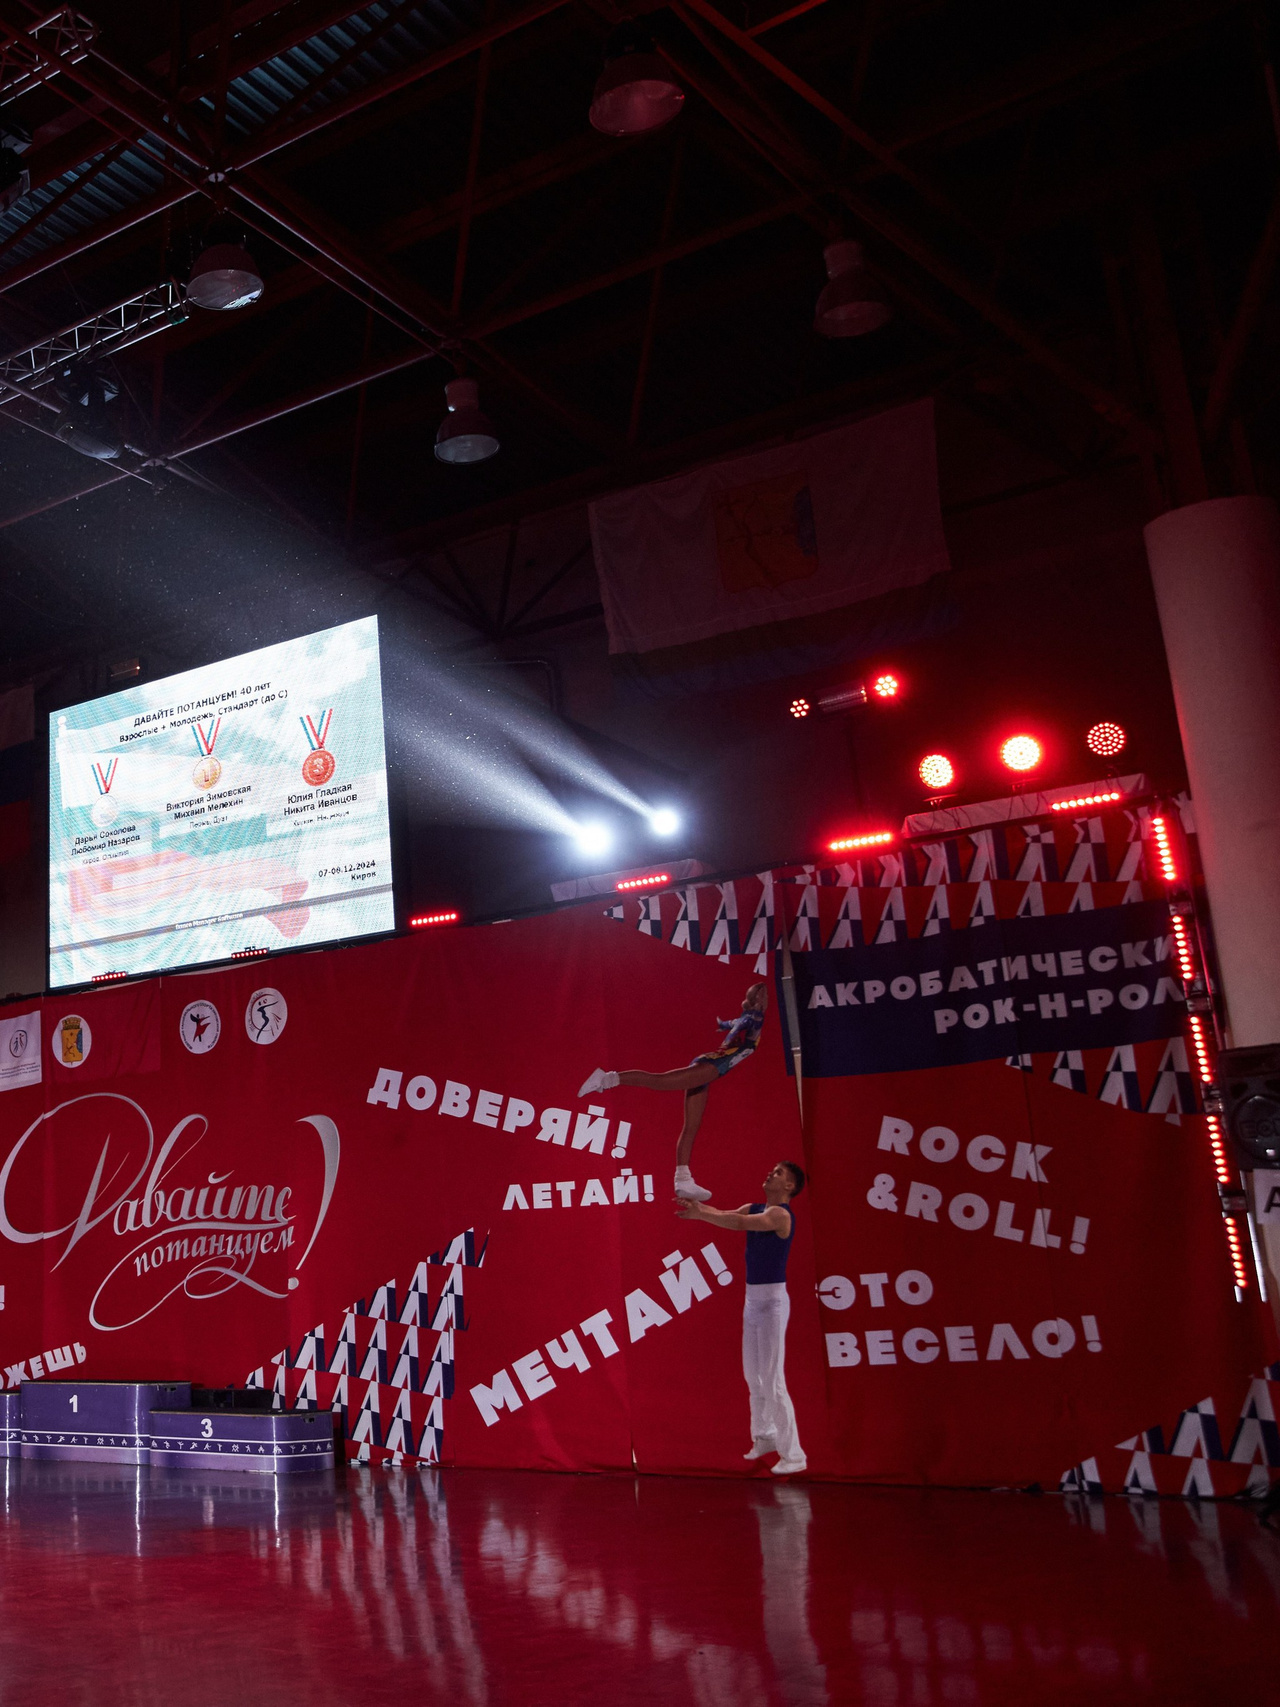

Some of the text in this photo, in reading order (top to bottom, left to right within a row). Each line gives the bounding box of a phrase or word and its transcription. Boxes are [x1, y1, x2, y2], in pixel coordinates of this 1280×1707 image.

[133, 681, 271, 727] ДАВАЙТЕ ПОТАНЦУЕМ! 40 лет
[119, 727, 158, 743] Взрослые
[166, 785, 252, 812] Виктория Зимовская
[174, 807, 205, 820] Михаил
[283, 793, 358, 817] Никита Иванцов
[287, 783, 352, 805] Юлия Гладкая
[808, 932, 1195, 1009] АКРОБАТИЧЕСКИ
[366, 1067, 632, 1159] ДОВЕРЯЙ!
[877, 1115, 1054, 1183] ROCK
[502, 1168, 655, 1211] ЛЕТАЙ!
[866, 1173, 1090, 1255] &ROLL!
[815, 1269, 934, 1311] ЭТО
[469, 1242, 734, 1428] МЕЧТАЙ!
[824, 1315, 1103, 1368] ВЕСЕЛО!
[69, 1394, 78, 1413] 1
[200, 1418, 214, 1438] 3
